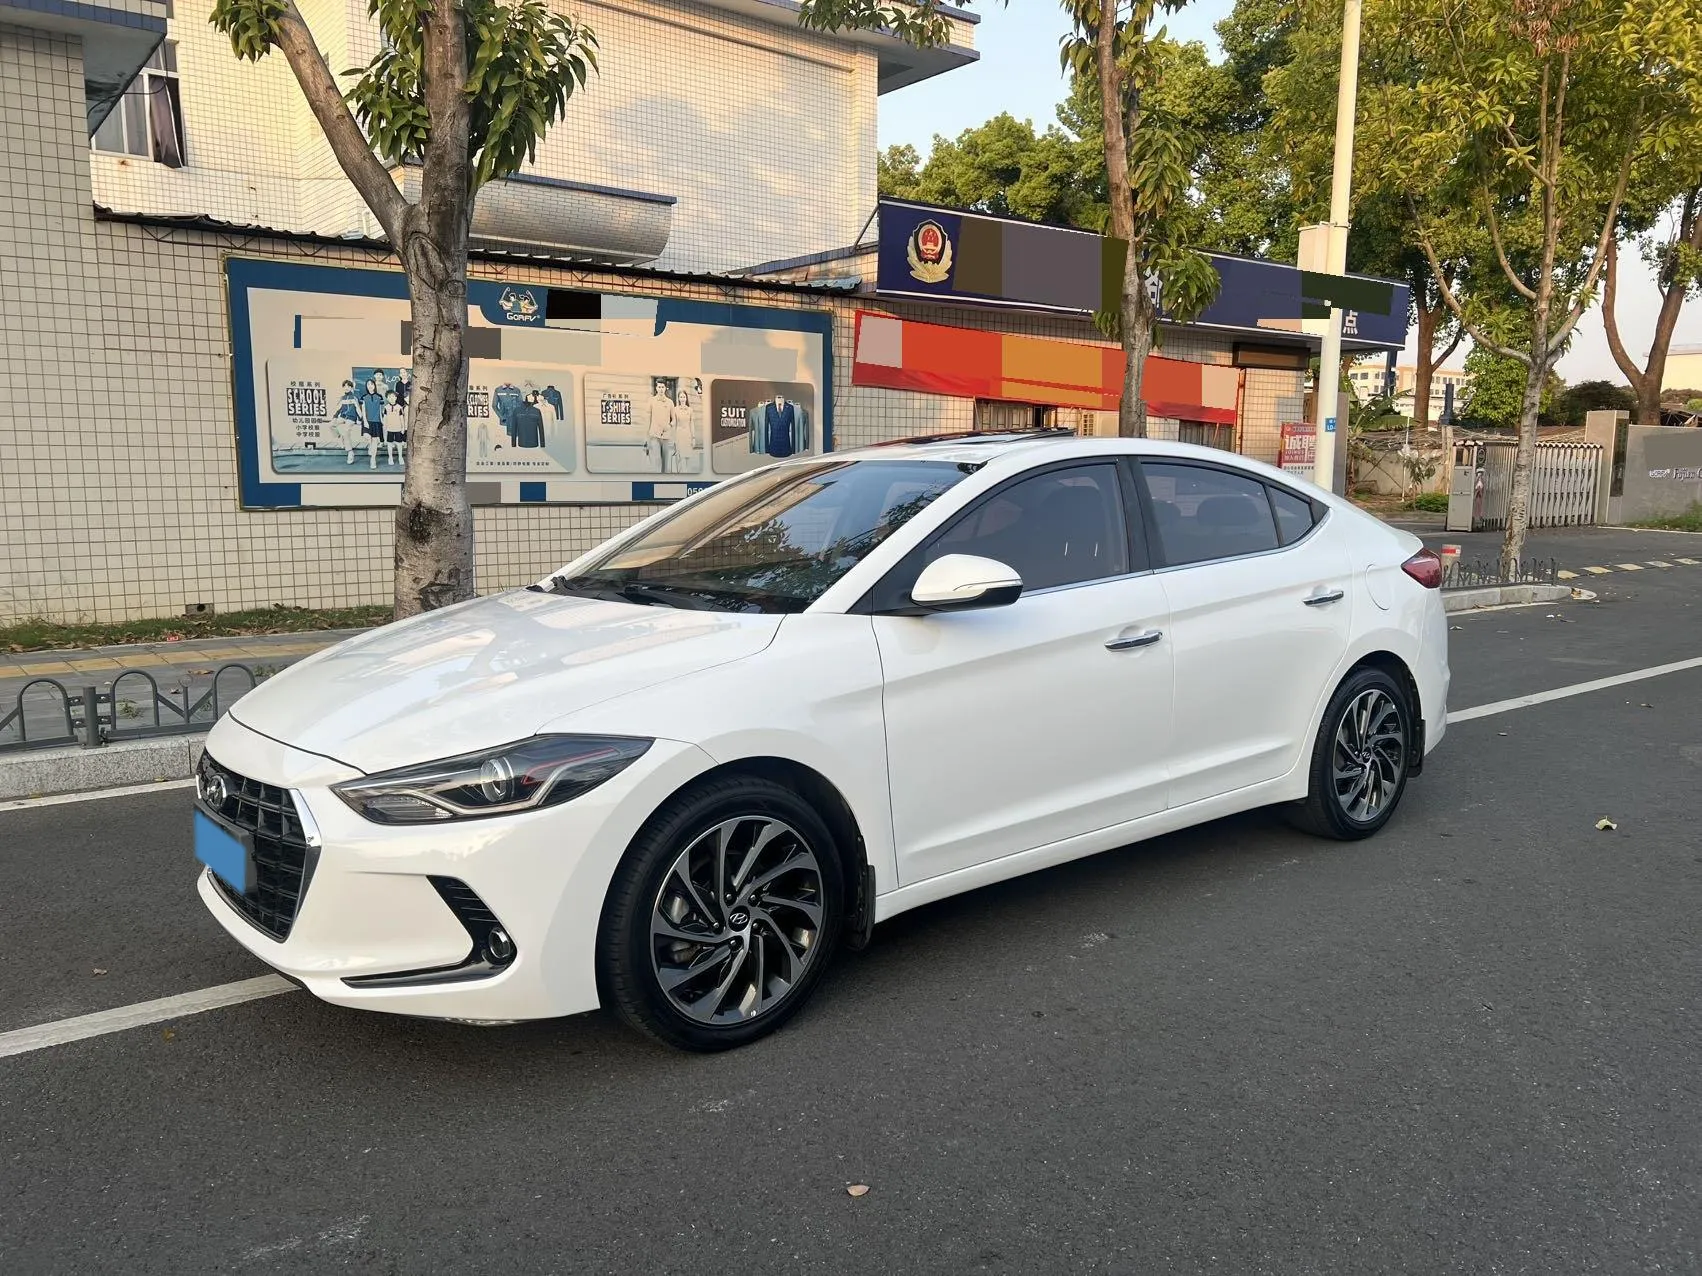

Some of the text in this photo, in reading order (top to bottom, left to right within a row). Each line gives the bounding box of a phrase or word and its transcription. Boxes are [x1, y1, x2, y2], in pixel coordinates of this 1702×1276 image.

[1343, 309, 1359, 335] 点
[287, 388, 326, 404] SCHOOL
[288, 403, 326, 415] SERIES
[467, 405, 489, 417] RIES
[721, 406, 746, 418] SUIT
[602, 412, 631, 424] SERIES
